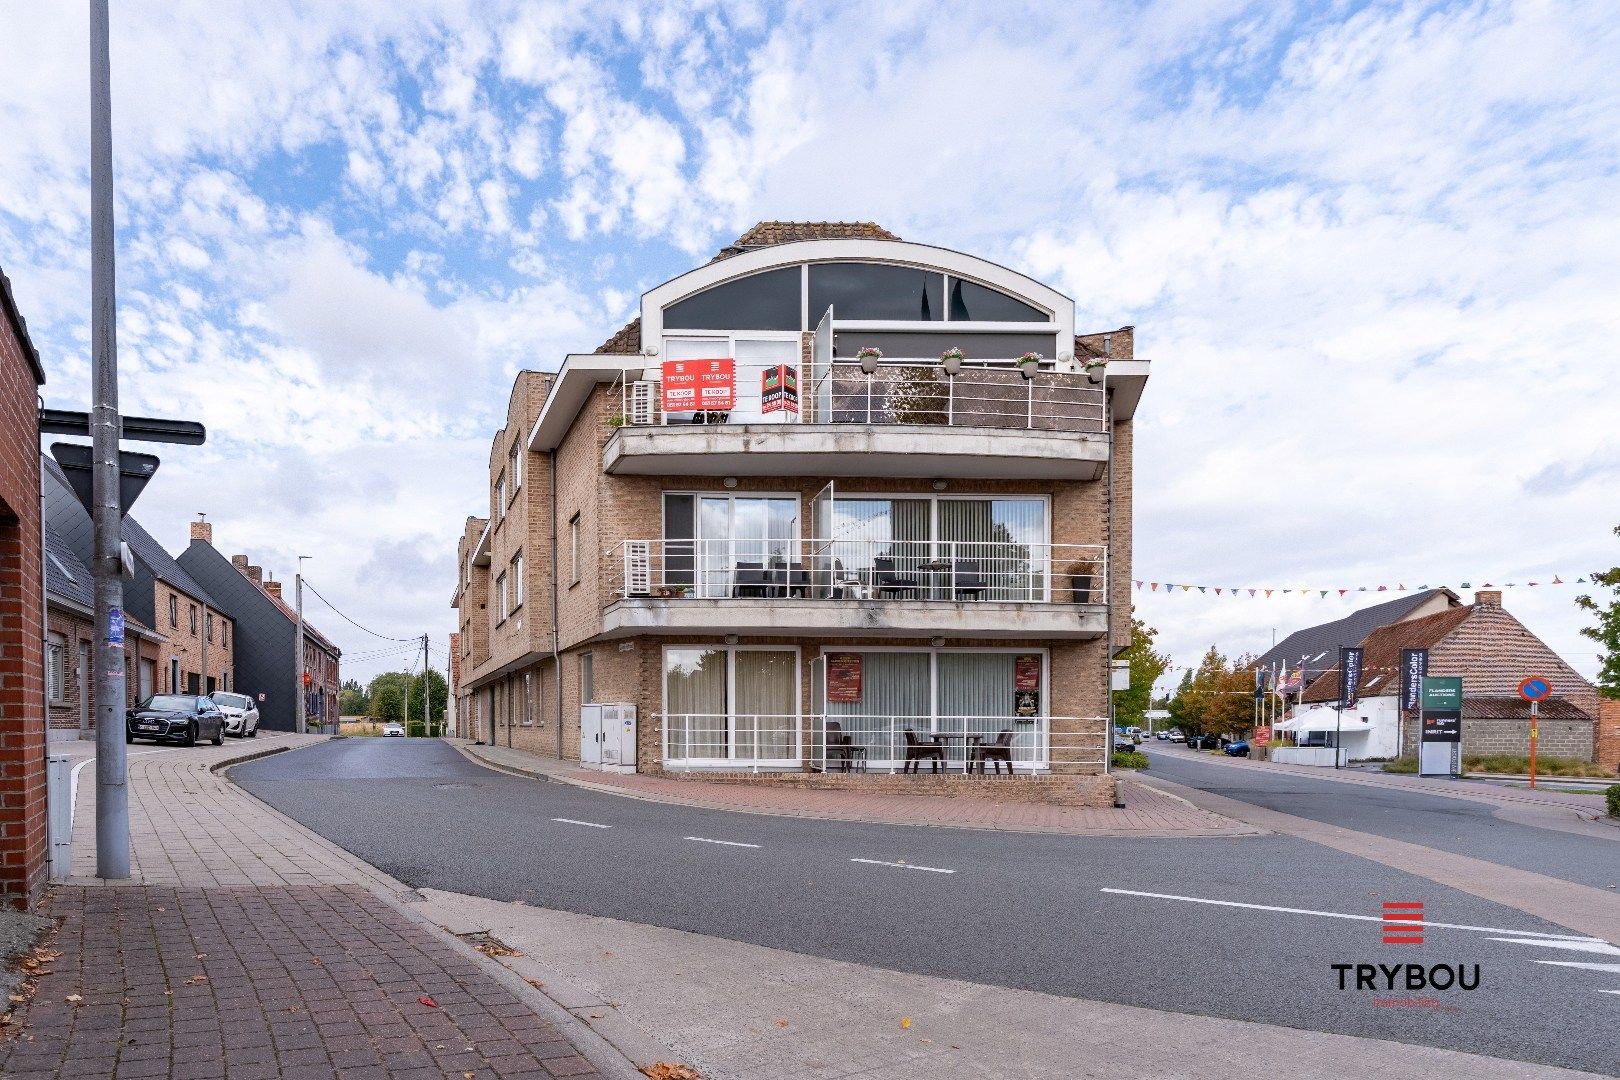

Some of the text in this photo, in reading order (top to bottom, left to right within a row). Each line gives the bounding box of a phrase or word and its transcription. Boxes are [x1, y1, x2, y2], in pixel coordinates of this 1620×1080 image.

[666, 374, 695, 382] TRYBOU
[701, 373, 731, 381] TRYBOU
[1407, 652, 1418, 709] FlandersColor
